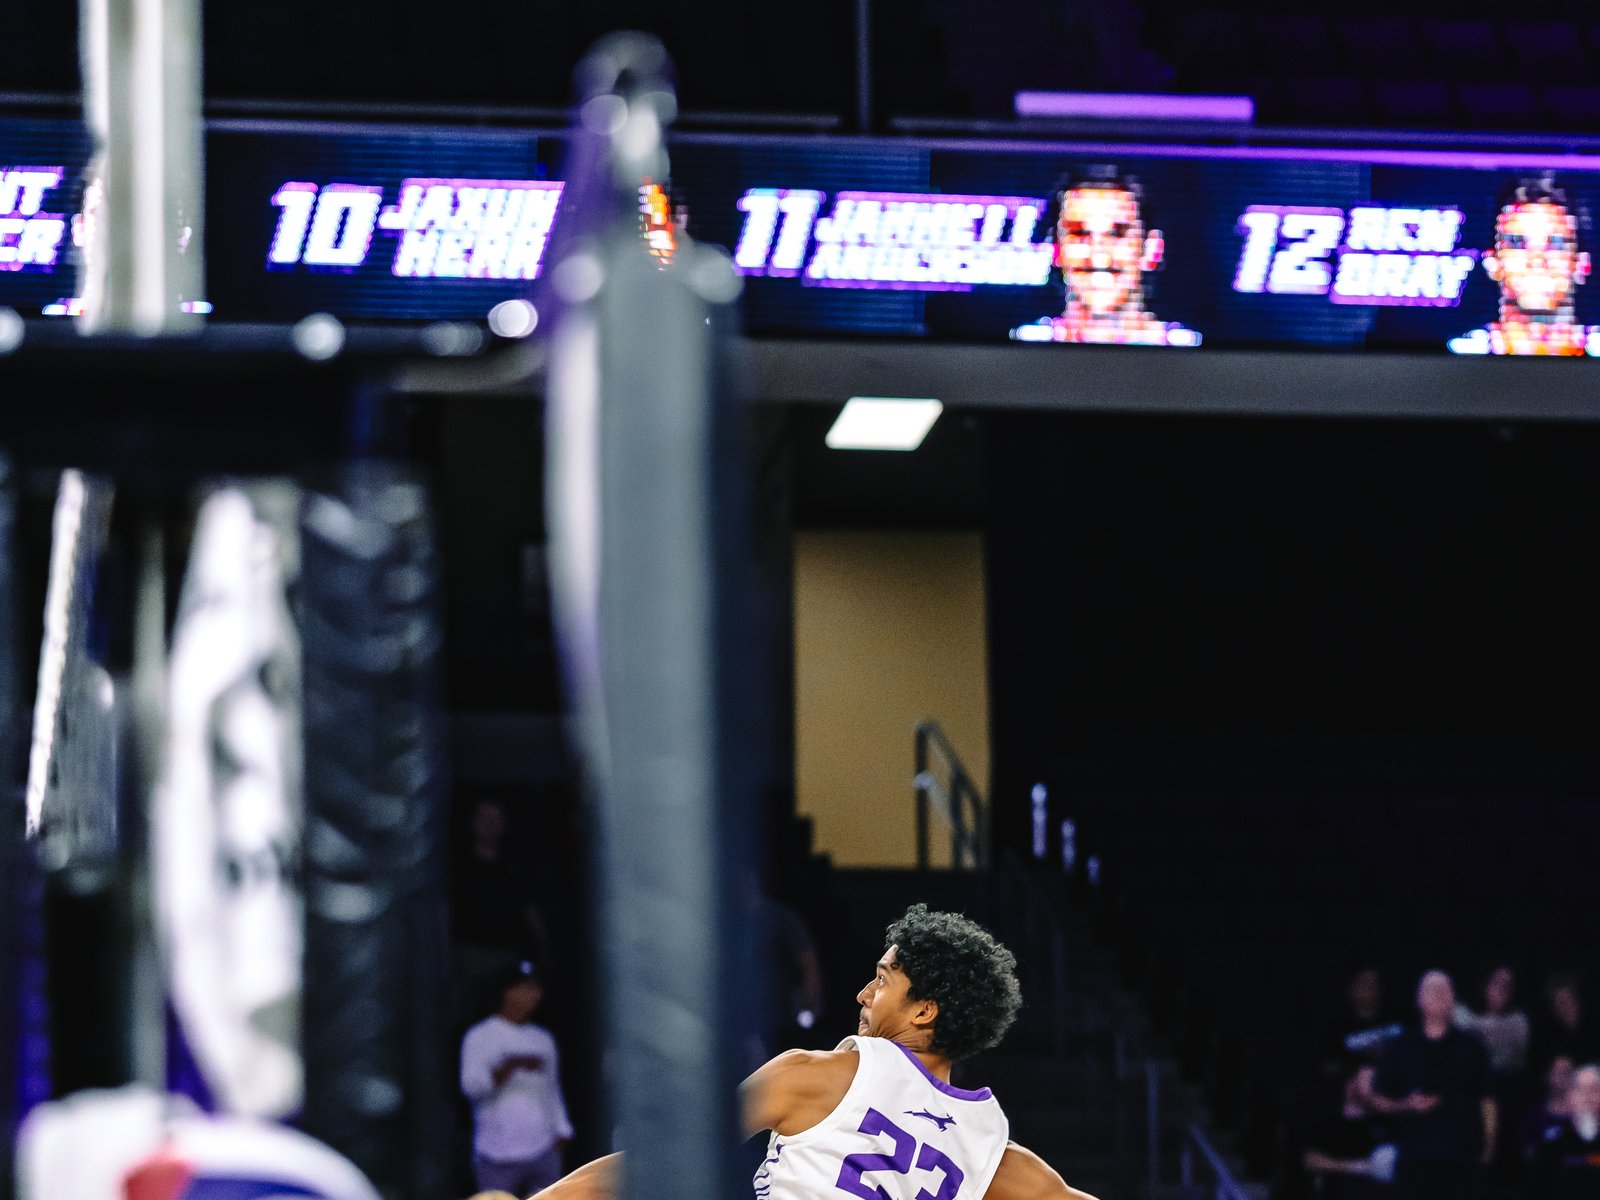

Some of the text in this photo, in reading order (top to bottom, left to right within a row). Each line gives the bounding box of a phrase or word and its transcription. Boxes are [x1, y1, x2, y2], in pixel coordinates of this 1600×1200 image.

[268, 183, 382, 266] 10
[736, 189, 825, 269] 11
[1232, 205, 1345, 294] 12
